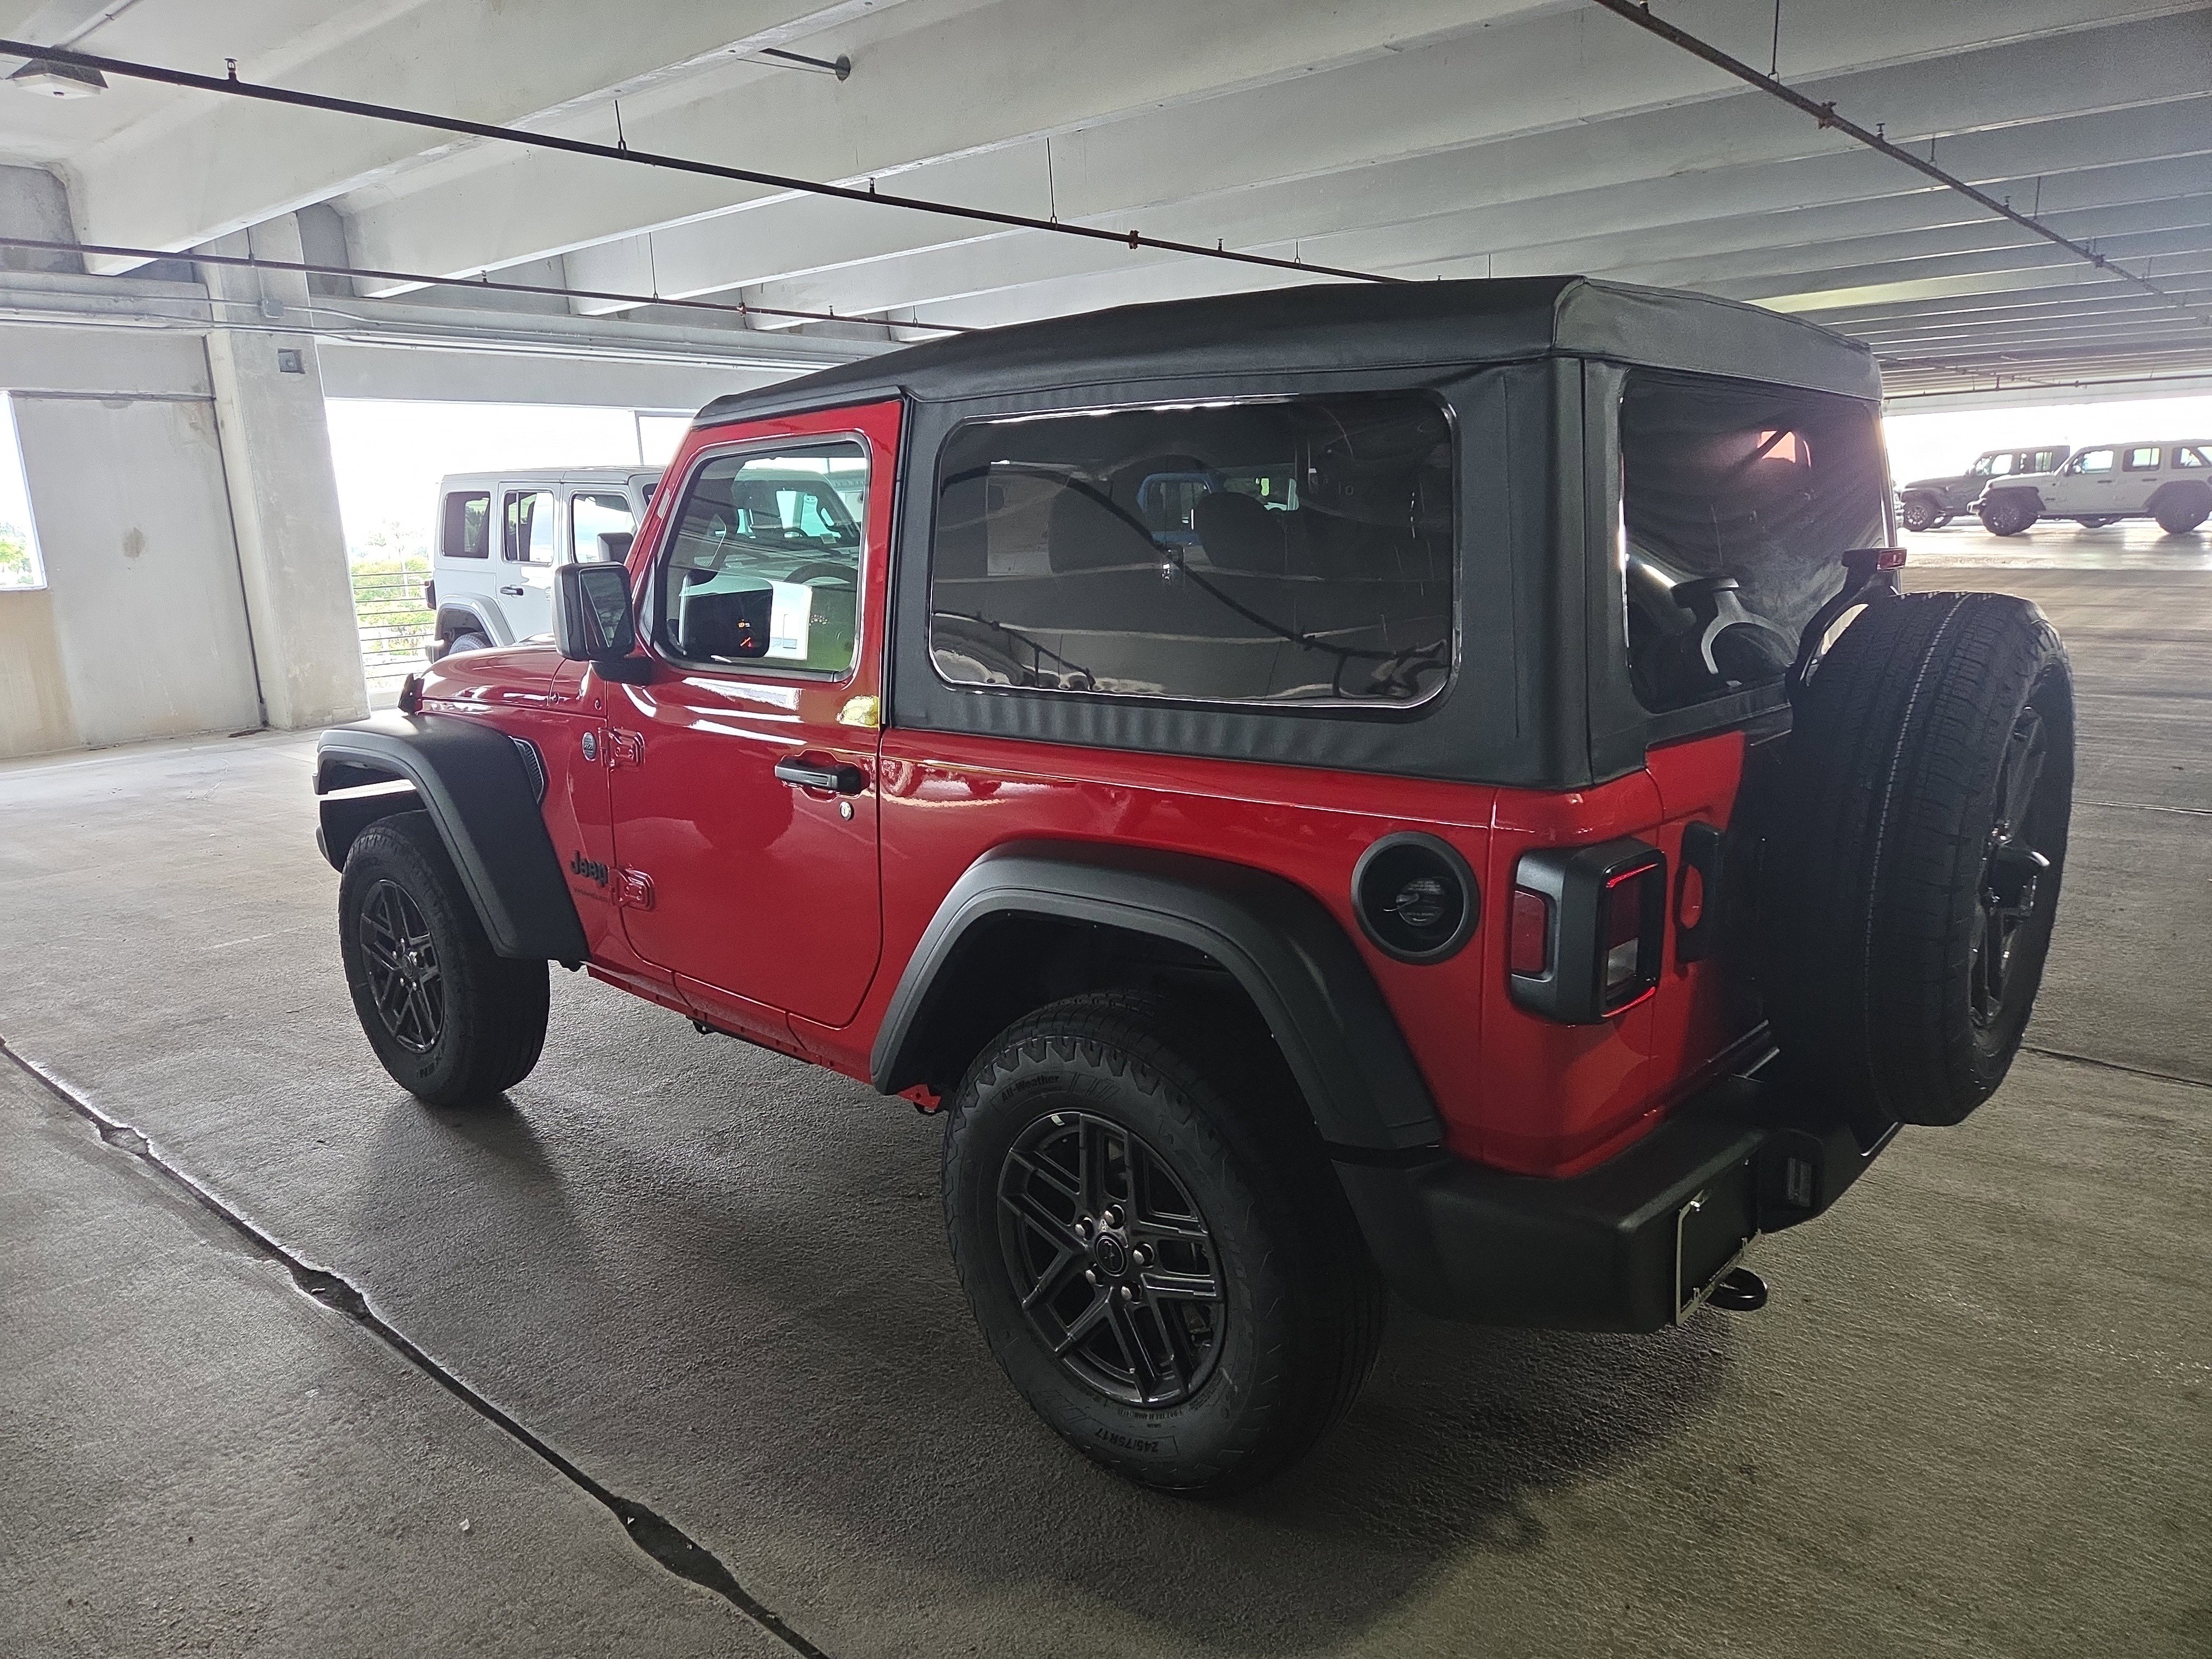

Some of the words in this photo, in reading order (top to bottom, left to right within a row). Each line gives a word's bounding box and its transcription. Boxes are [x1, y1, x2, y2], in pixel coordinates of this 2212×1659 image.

[571, 850, 608, 888] Jeep
[1002, 1075, 1060, 1102] All-Weather
[1094, 1427, 1159, 1452] 245/75R17
